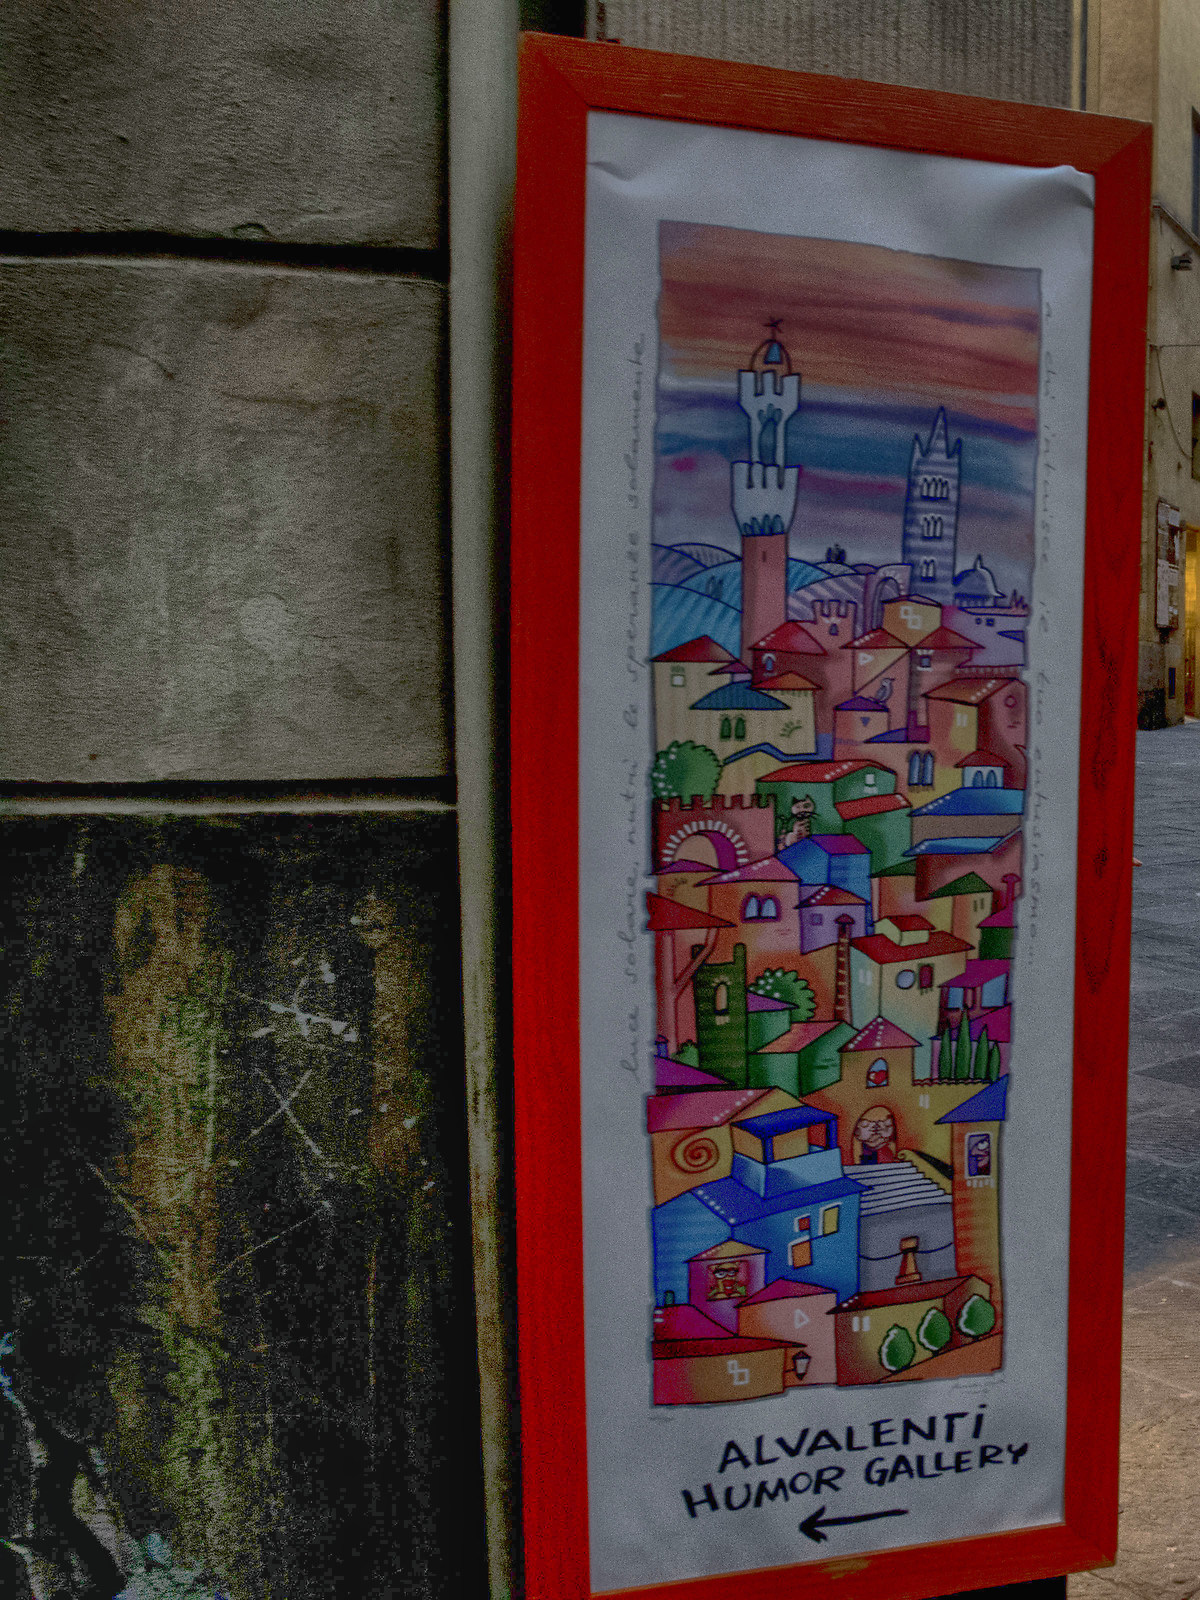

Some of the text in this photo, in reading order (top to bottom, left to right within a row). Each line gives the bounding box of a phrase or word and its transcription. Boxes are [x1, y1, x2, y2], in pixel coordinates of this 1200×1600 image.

[620, 1007, 640, 1081] luce
[681, 1442, 1030, 1518] HUMOR GALLERY
